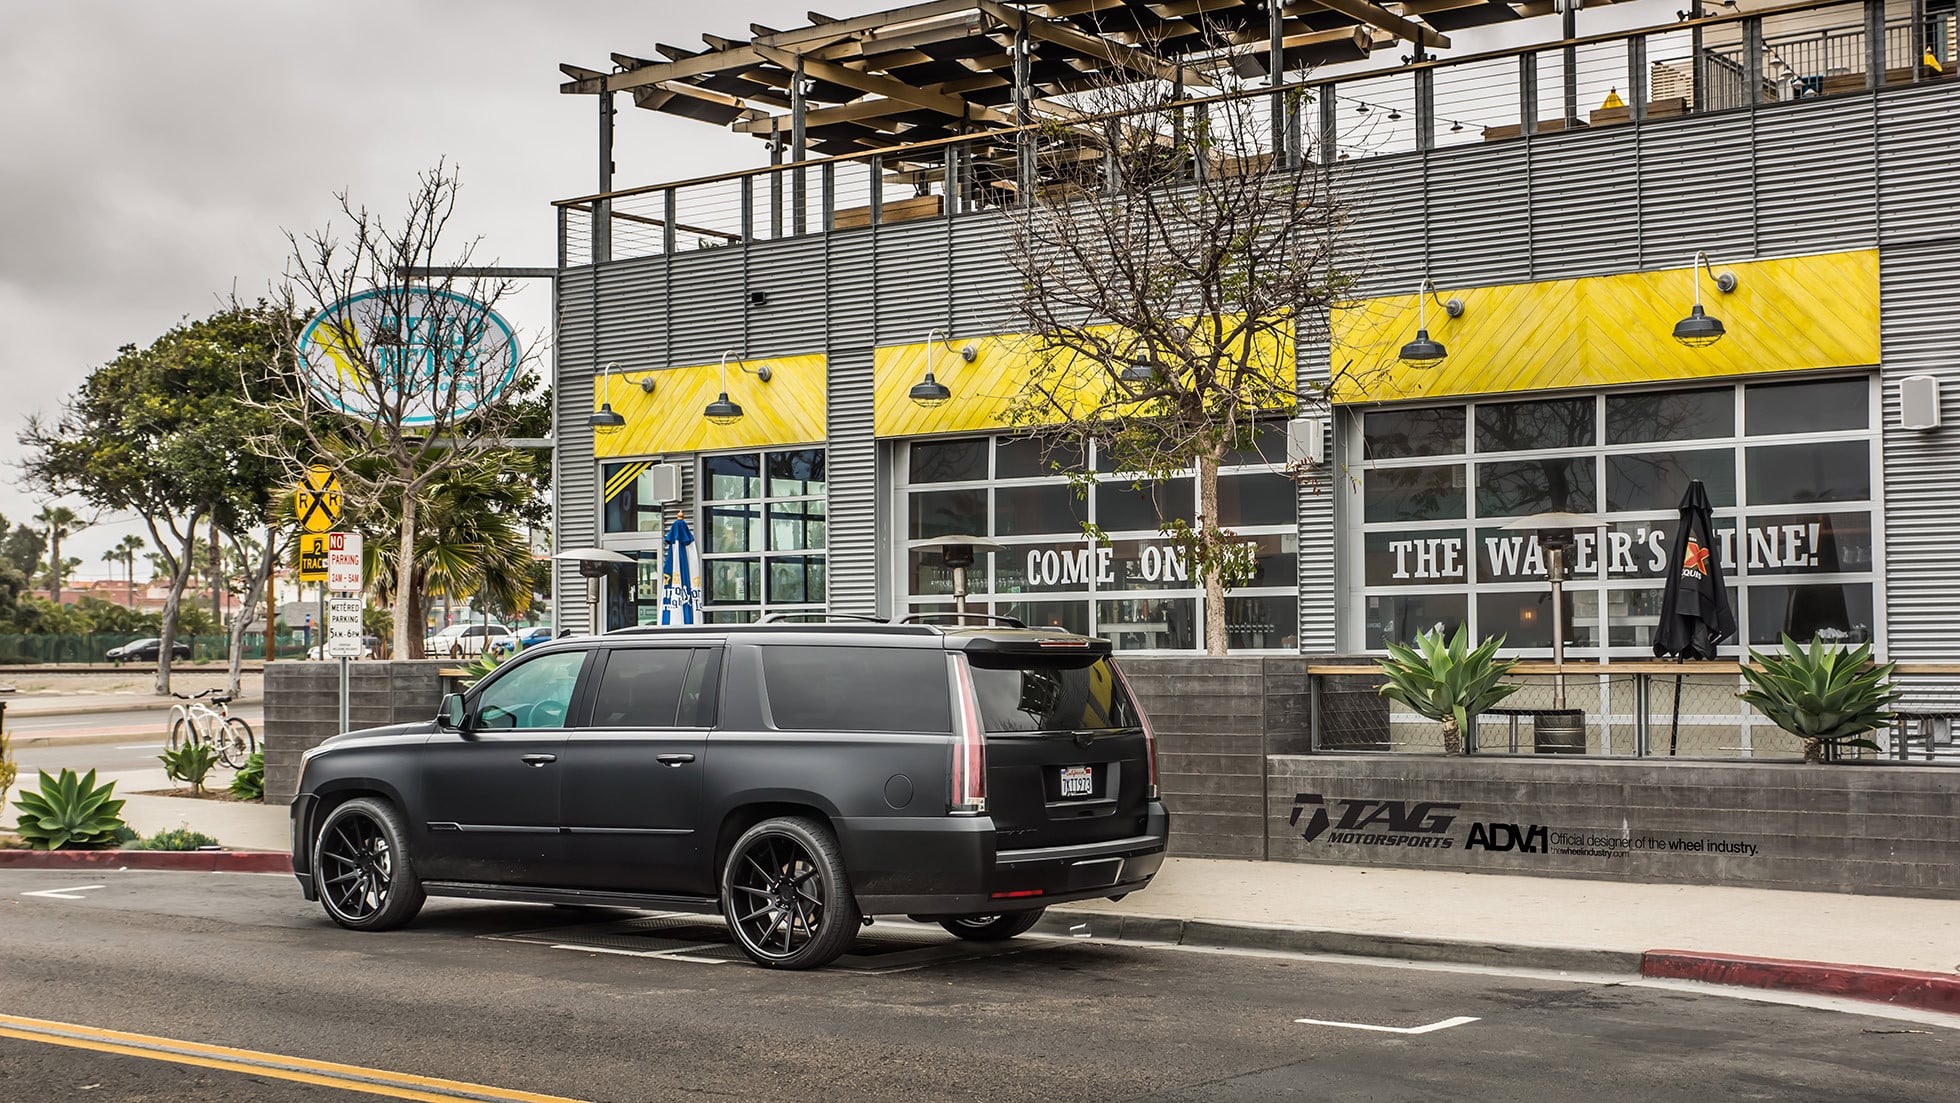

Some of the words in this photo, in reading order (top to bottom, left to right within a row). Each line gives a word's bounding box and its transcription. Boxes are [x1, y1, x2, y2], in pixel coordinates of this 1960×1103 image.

[299, 493, 308, 509] R
[329, 492, 338, 506] R
[330, 535, 343, 549] NO
[314, 543, 321, 555] 2
[1389, 538, 1464, 579] THE
[1485, 528, 1667, 577] WAER'S
[1712, 523, 1820, 568] INE!
[303, 558, 329, 570] TRAC
[331, 554, 360, 566] PARKING
[1027, 547, 1115, 585] COME
[1141, 546, 1188, 581] ON
[331, 603, 360, 612] METERED
[331, 615, 359, 624] PARKING
